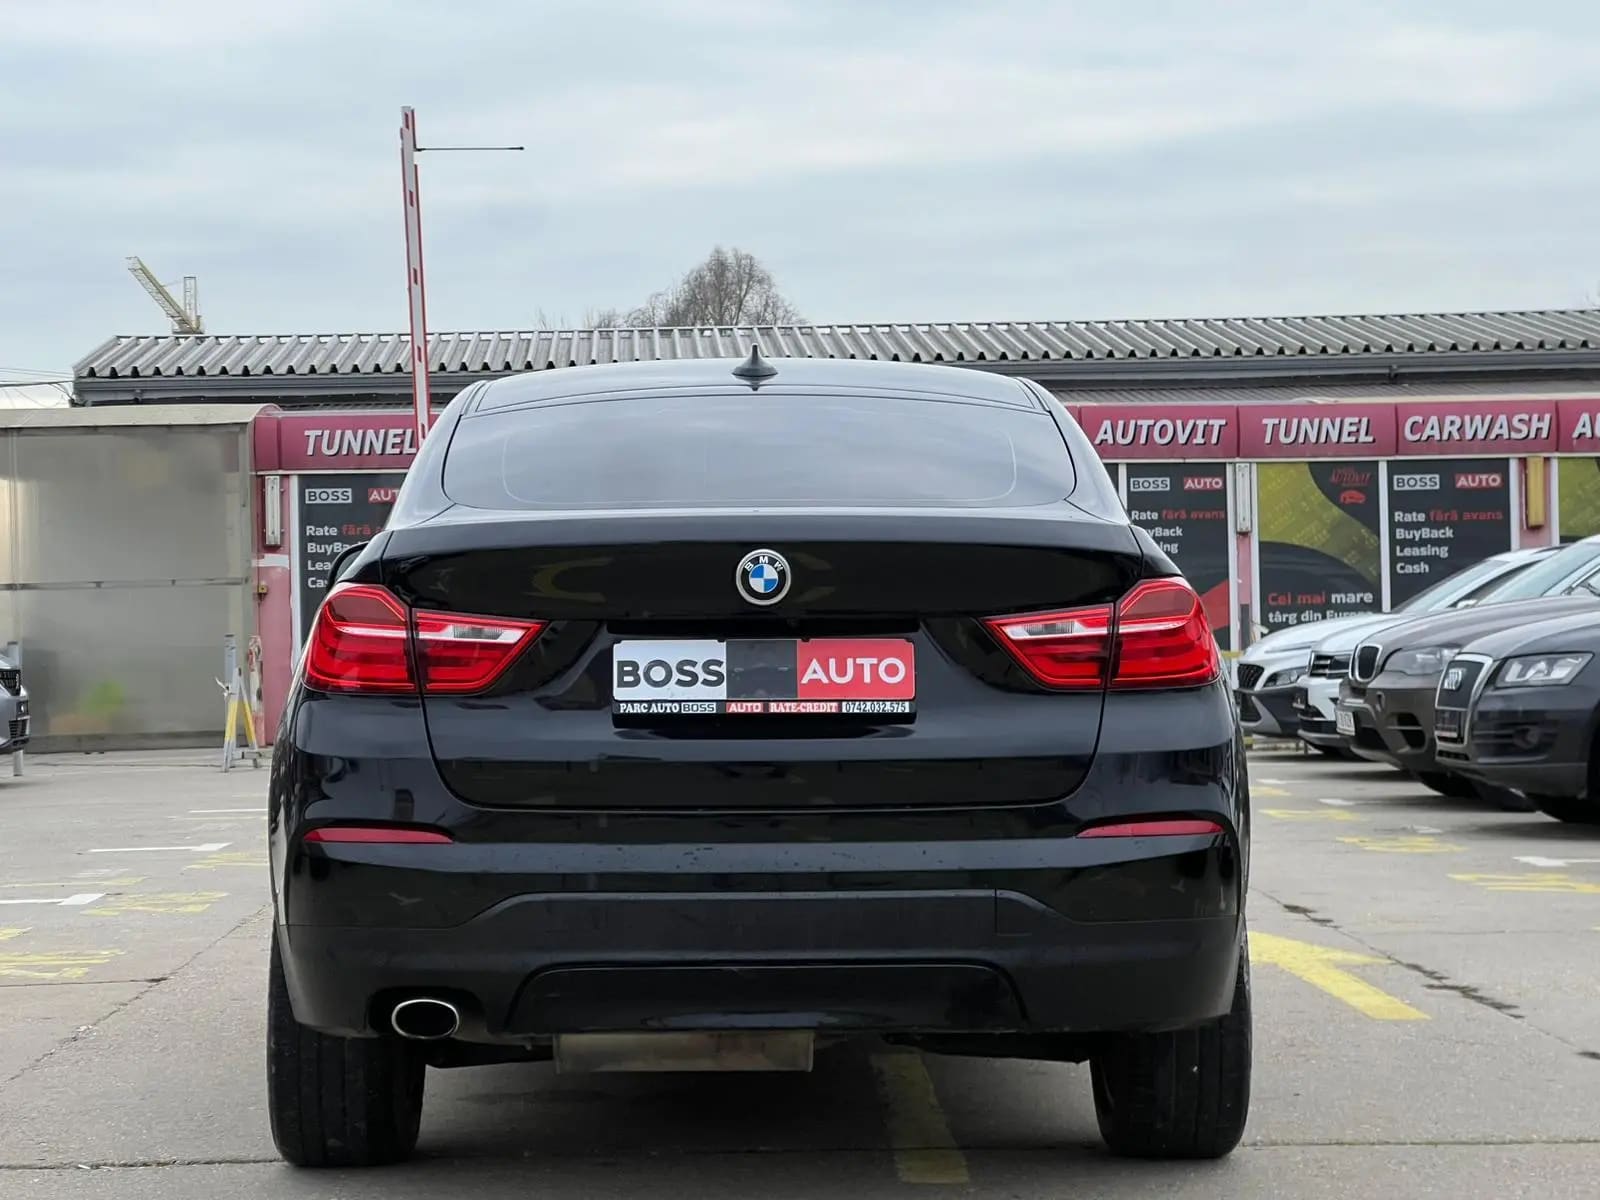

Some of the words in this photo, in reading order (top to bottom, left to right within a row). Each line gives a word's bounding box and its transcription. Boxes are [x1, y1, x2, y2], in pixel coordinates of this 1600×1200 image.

[1095, 419, 1227, 446] AUTOVIT
[1262, 416, 1376, 445] TUNNEL
[1404, 413, 1552, 443] CARWASH
[304, 428, 418, 456] TUNNEL
[1132, 480, 1168, 489] BOSS
[1184, 478, 1223, 489] AUTO
[1396, 476, 1438, 488] BOSS
[1456, 474, 1501, 488] AUTO
[307, 491, 350, 502] BOSS
[1131, 510, 1159, 520] Rate
[1394, 511, 1426, 522] Rate
[306, 525, 338, 536] Rate
[1395, 527, 1454, 541] BuyBack
[1396, 544, 1449, 558] Leasing
[744, 555, 784, 572] BMW
[1396, 562, 1430, 574] Cash
[1331, 592, 1374, 604] mare
[1268, 611, 1298, 625] târg
[1301, 610, 1322, 622] din
[616, 659, 726, 689] BOSS
[800, 657, 906, 684] AUTO
[620, 702, 648, 714] PARC
[650, 702, 679, 714] AUTO
[682, 703, 715, 713] BOSS
[729, 702, 761, 713] AUTO
[769, 702, 838, 713] RATE-CREDIT
